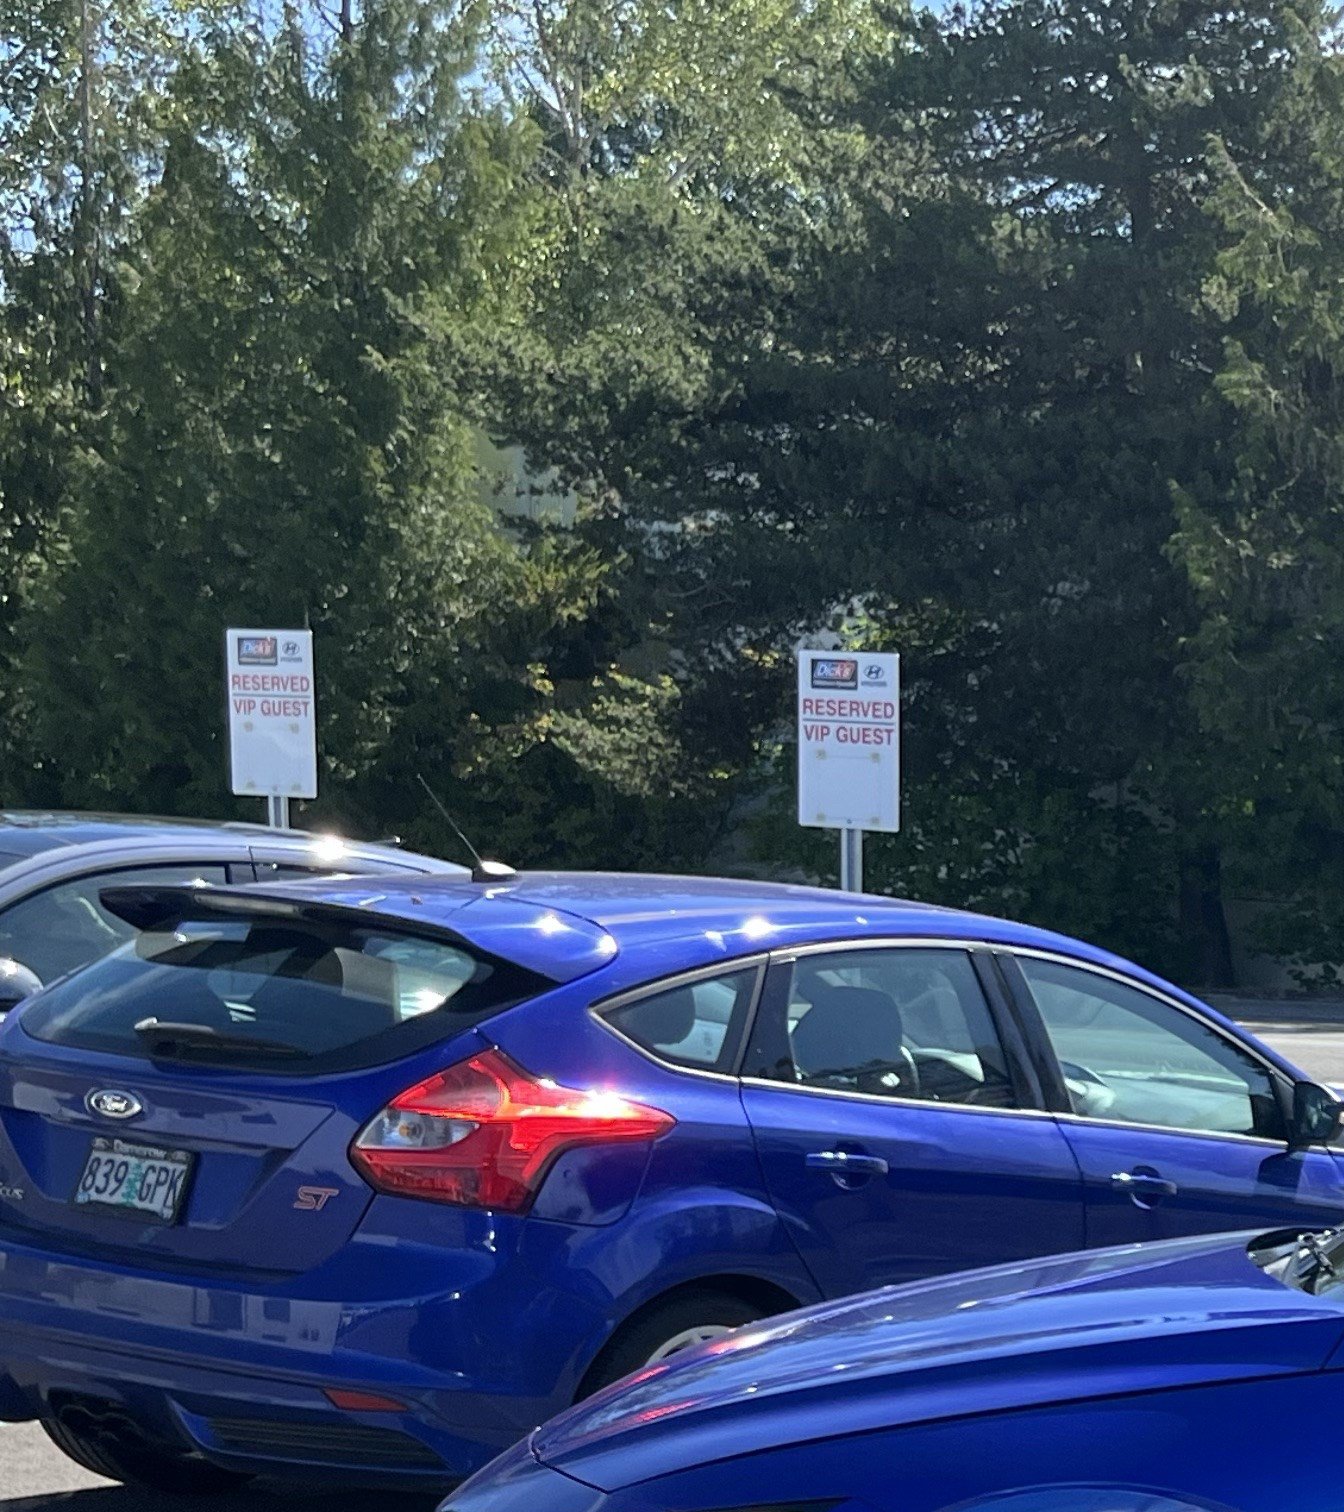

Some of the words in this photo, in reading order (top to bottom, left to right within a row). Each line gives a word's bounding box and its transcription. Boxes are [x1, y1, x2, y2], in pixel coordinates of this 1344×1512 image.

[231, 674, 310, 693] RESERVED
[233, 699, 257, 715] VIP
[260, 701, 311, 718] GUEST
[802, 698, 895, 719] RESERVED
[803, 724, 831, 742] VIP
[835, 726, 895, 746] GUEST
[81, 1156, 129, 1197] 839
[137, 1164, 186, 1209] GPK
[293, 1185, 340, 1211] ST
